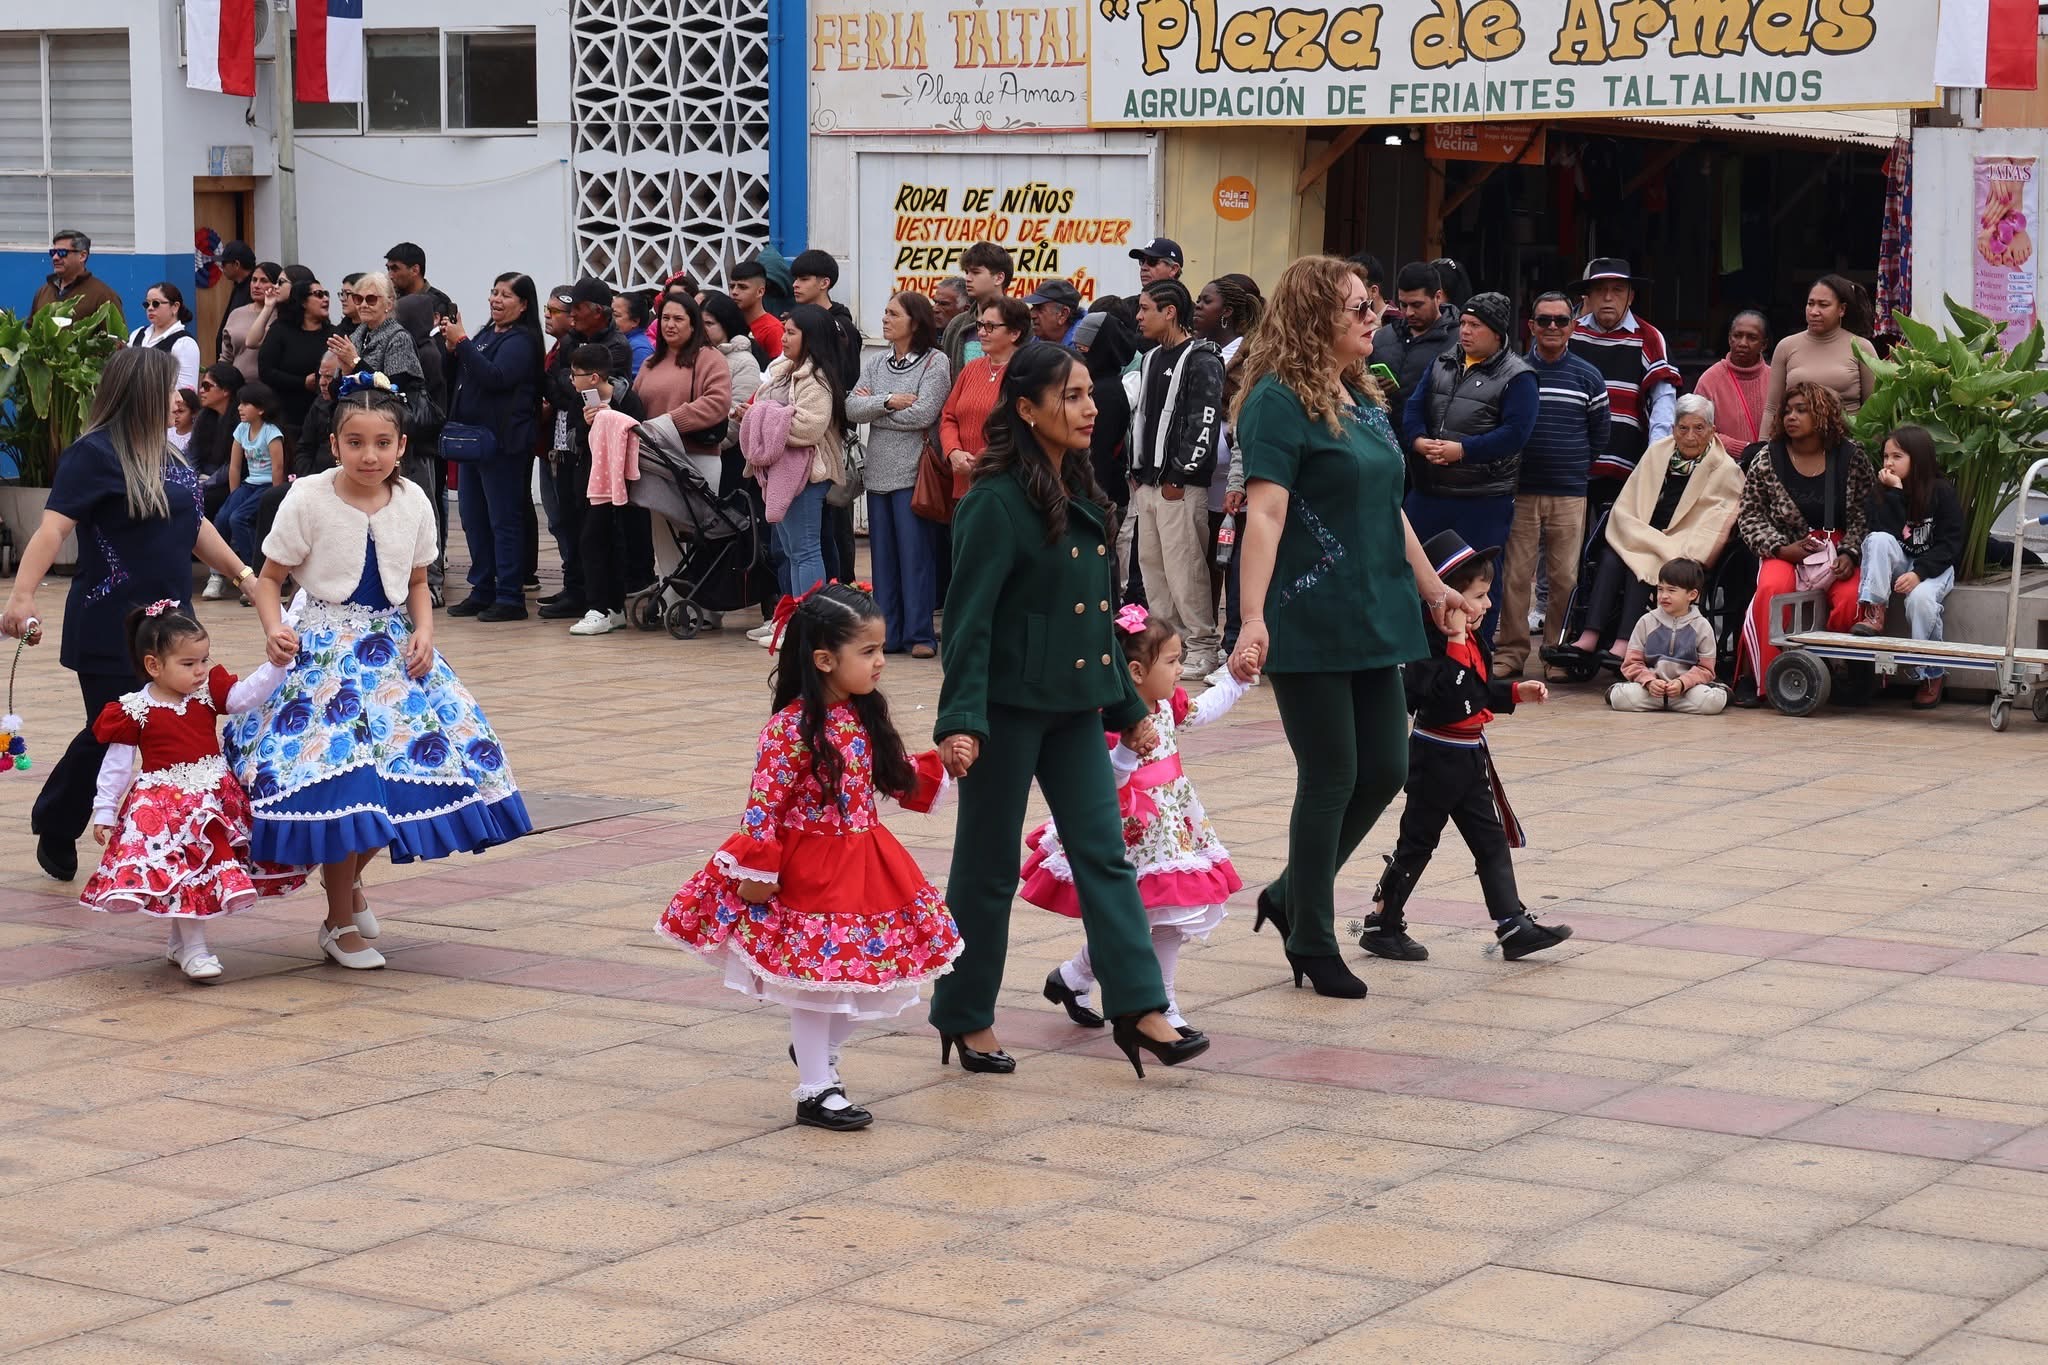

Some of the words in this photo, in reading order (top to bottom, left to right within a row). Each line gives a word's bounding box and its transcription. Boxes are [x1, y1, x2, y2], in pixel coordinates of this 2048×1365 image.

[812, 11, 928, 71] FERIA
[948, 6, 1087, 69] TALTAL
[1411, 0, 1525, 70] de
[1549, 0, 1876, 65] Armas
[916, 72, 970, 120] Plaza
[975, 74, 995, 104] de
[998, 72, 1077, 104] Armas
[1124, 77, 1304, 118] AGRUPACIÓN
[1328, 85, 1366, 115] DE
[1389, 78, 1576, 115] FERIANTES
[1603, 70, 1822, 107] TALTALINOS
[1434, 123, 1463, 138] Caja
[1434, 137, 1478, 152] Vecina
[895, 184, 948, 213] ROPA
[963, 188, 994, 212] DE
[1000, 183, 1074, 214] NIÑOS
[1219, 189, 1239, 200] Caja
[1219, 198, 1249, 208] Vecina
[1018, 218, 1045, 242] DE
[1054, 218, 1132, 245] MUJER
[894, 239, 1058, 272] PERFRÍA
